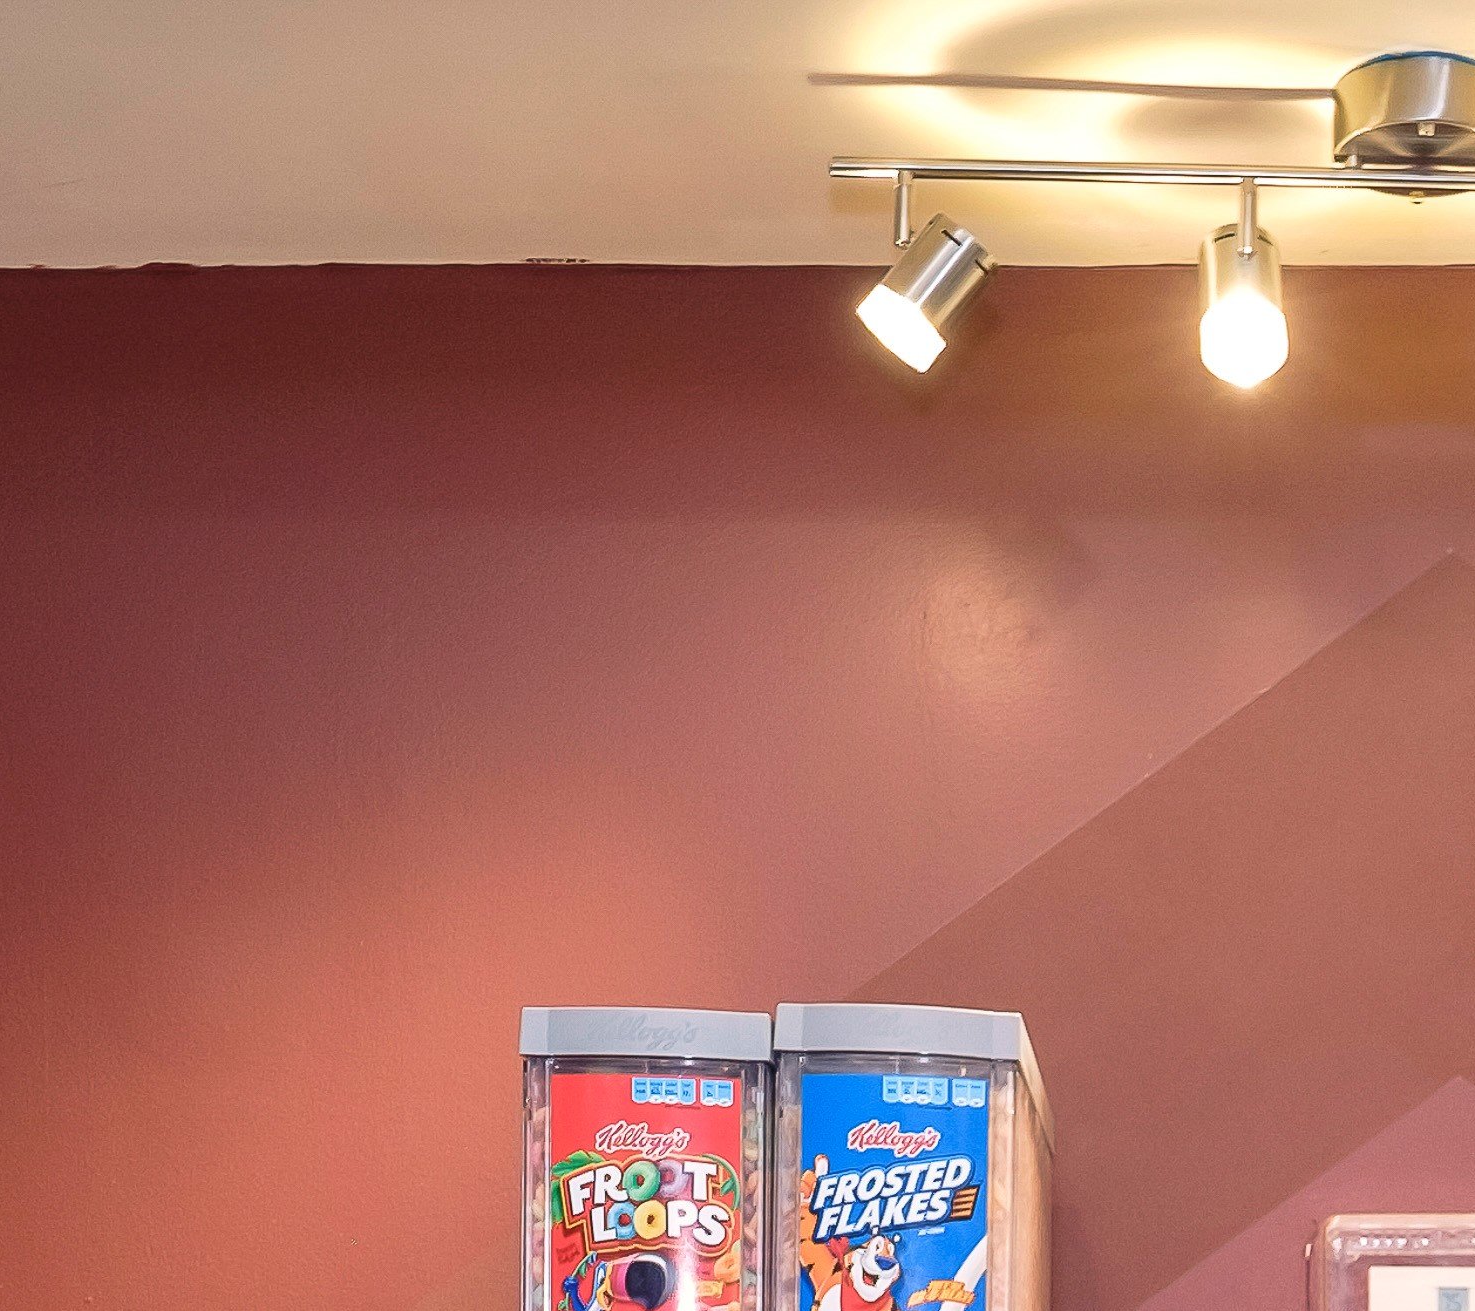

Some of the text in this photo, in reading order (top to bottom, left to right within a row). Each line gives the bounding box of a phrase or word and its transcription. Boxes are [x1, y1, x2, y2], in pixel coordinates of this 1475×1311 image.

[597, 1122, 689, 1157] Kellogg's
[848, 1121, 940, 1157] Kellogg's
[568, 1159, 718, 1215] FROOT
[814, 1157, 972, 1211] FROSTED
[591, 1200, 729, 1246] LOOPS
[817, 1189, 950, 1239] FLAKES
